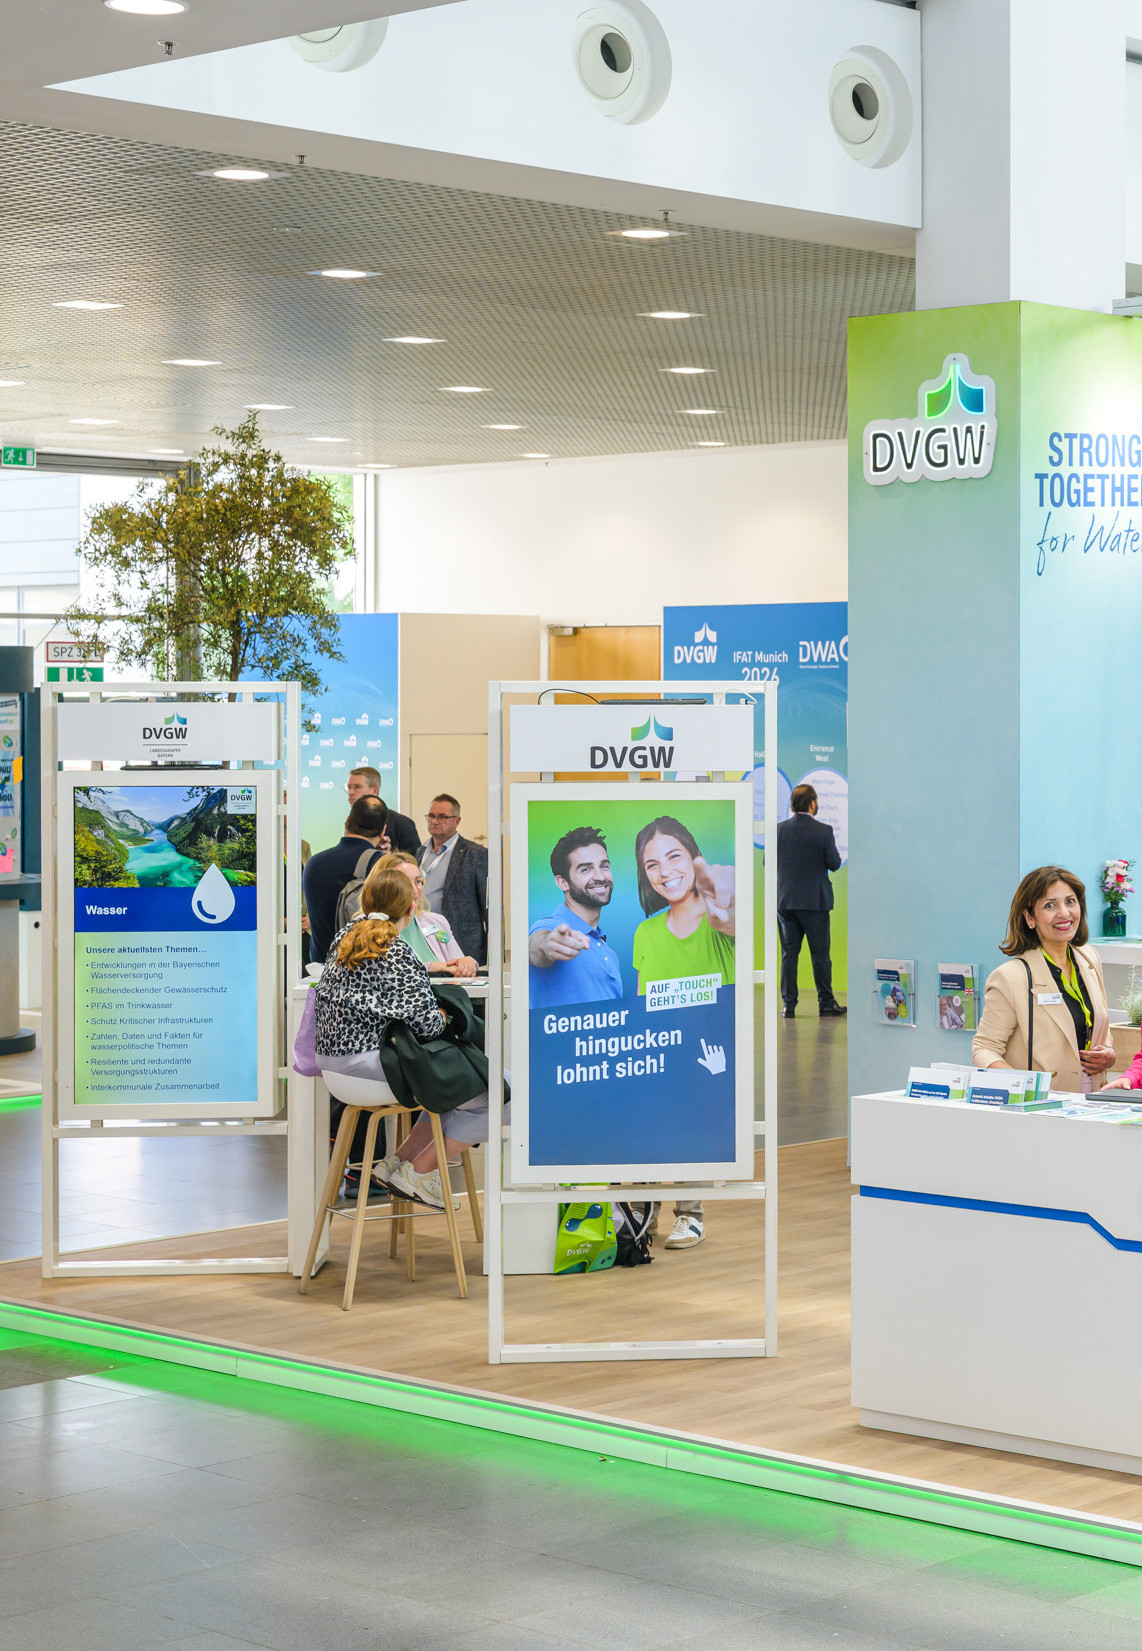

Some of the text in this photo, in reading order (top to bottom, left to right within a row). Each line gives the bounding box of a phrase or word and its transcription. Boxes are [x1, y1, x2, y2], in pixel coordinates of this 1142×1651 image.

[870, 423, 987, 474] DVGW
[1048, 432, 1142, 467] STRONG
[1036, 511, 1075, 576] for
[53, 646, 74, 658] SPZ
[674, 645, 718, 664] DVGW
[733, 650, 788, 663] IFAT Munich
[799, 640, 840, 663] DWA
[741, 666, 780, 684] 2026
[142, 727, 188, 740] DVGW
[590, 745, 675, 769] DVGW
[86, 905, 127, 915] Wasser
[86, 946, 115, 954] Unsere
[117, 946, 162, 954] aktuellsten
[91, 961, 147, 970] Entwicklungen
[172, 960, 220, 969] Bayerischen
[91, 971, 163, 980] Wasserversorgung
[650, 983, 671, 995] AUF
[689, 990, 714, 1003] LOS!
[91, 1002, 113, 1010] PFAS
[126, 1001, 173, 1009] Trinkwasser
[91, 1016, 213, 1025] Schutz Kritischer Infrastrukturen
[543, 1010, 629, 1034] Genauer
[147, 1032, 162, 1040] und
[192, 1031, 203, 1039] für
[575, 1027, 683, 1056] hingucken
[91, 1042, 188, 1051] wasserpolitische Themen
[91, 1058, 129, 1066] Resiliente
[147, 1057, 192, 1065] redundante
[91, 1068, 178, 1077] Versorgungsstrukturen
[556, 1054, 665, 1085] lohnt sich!
[91, 1082, 220, 1091] Interkommunale Zusammenarbeit
[566, 1248, 591, 1257] DVGW
